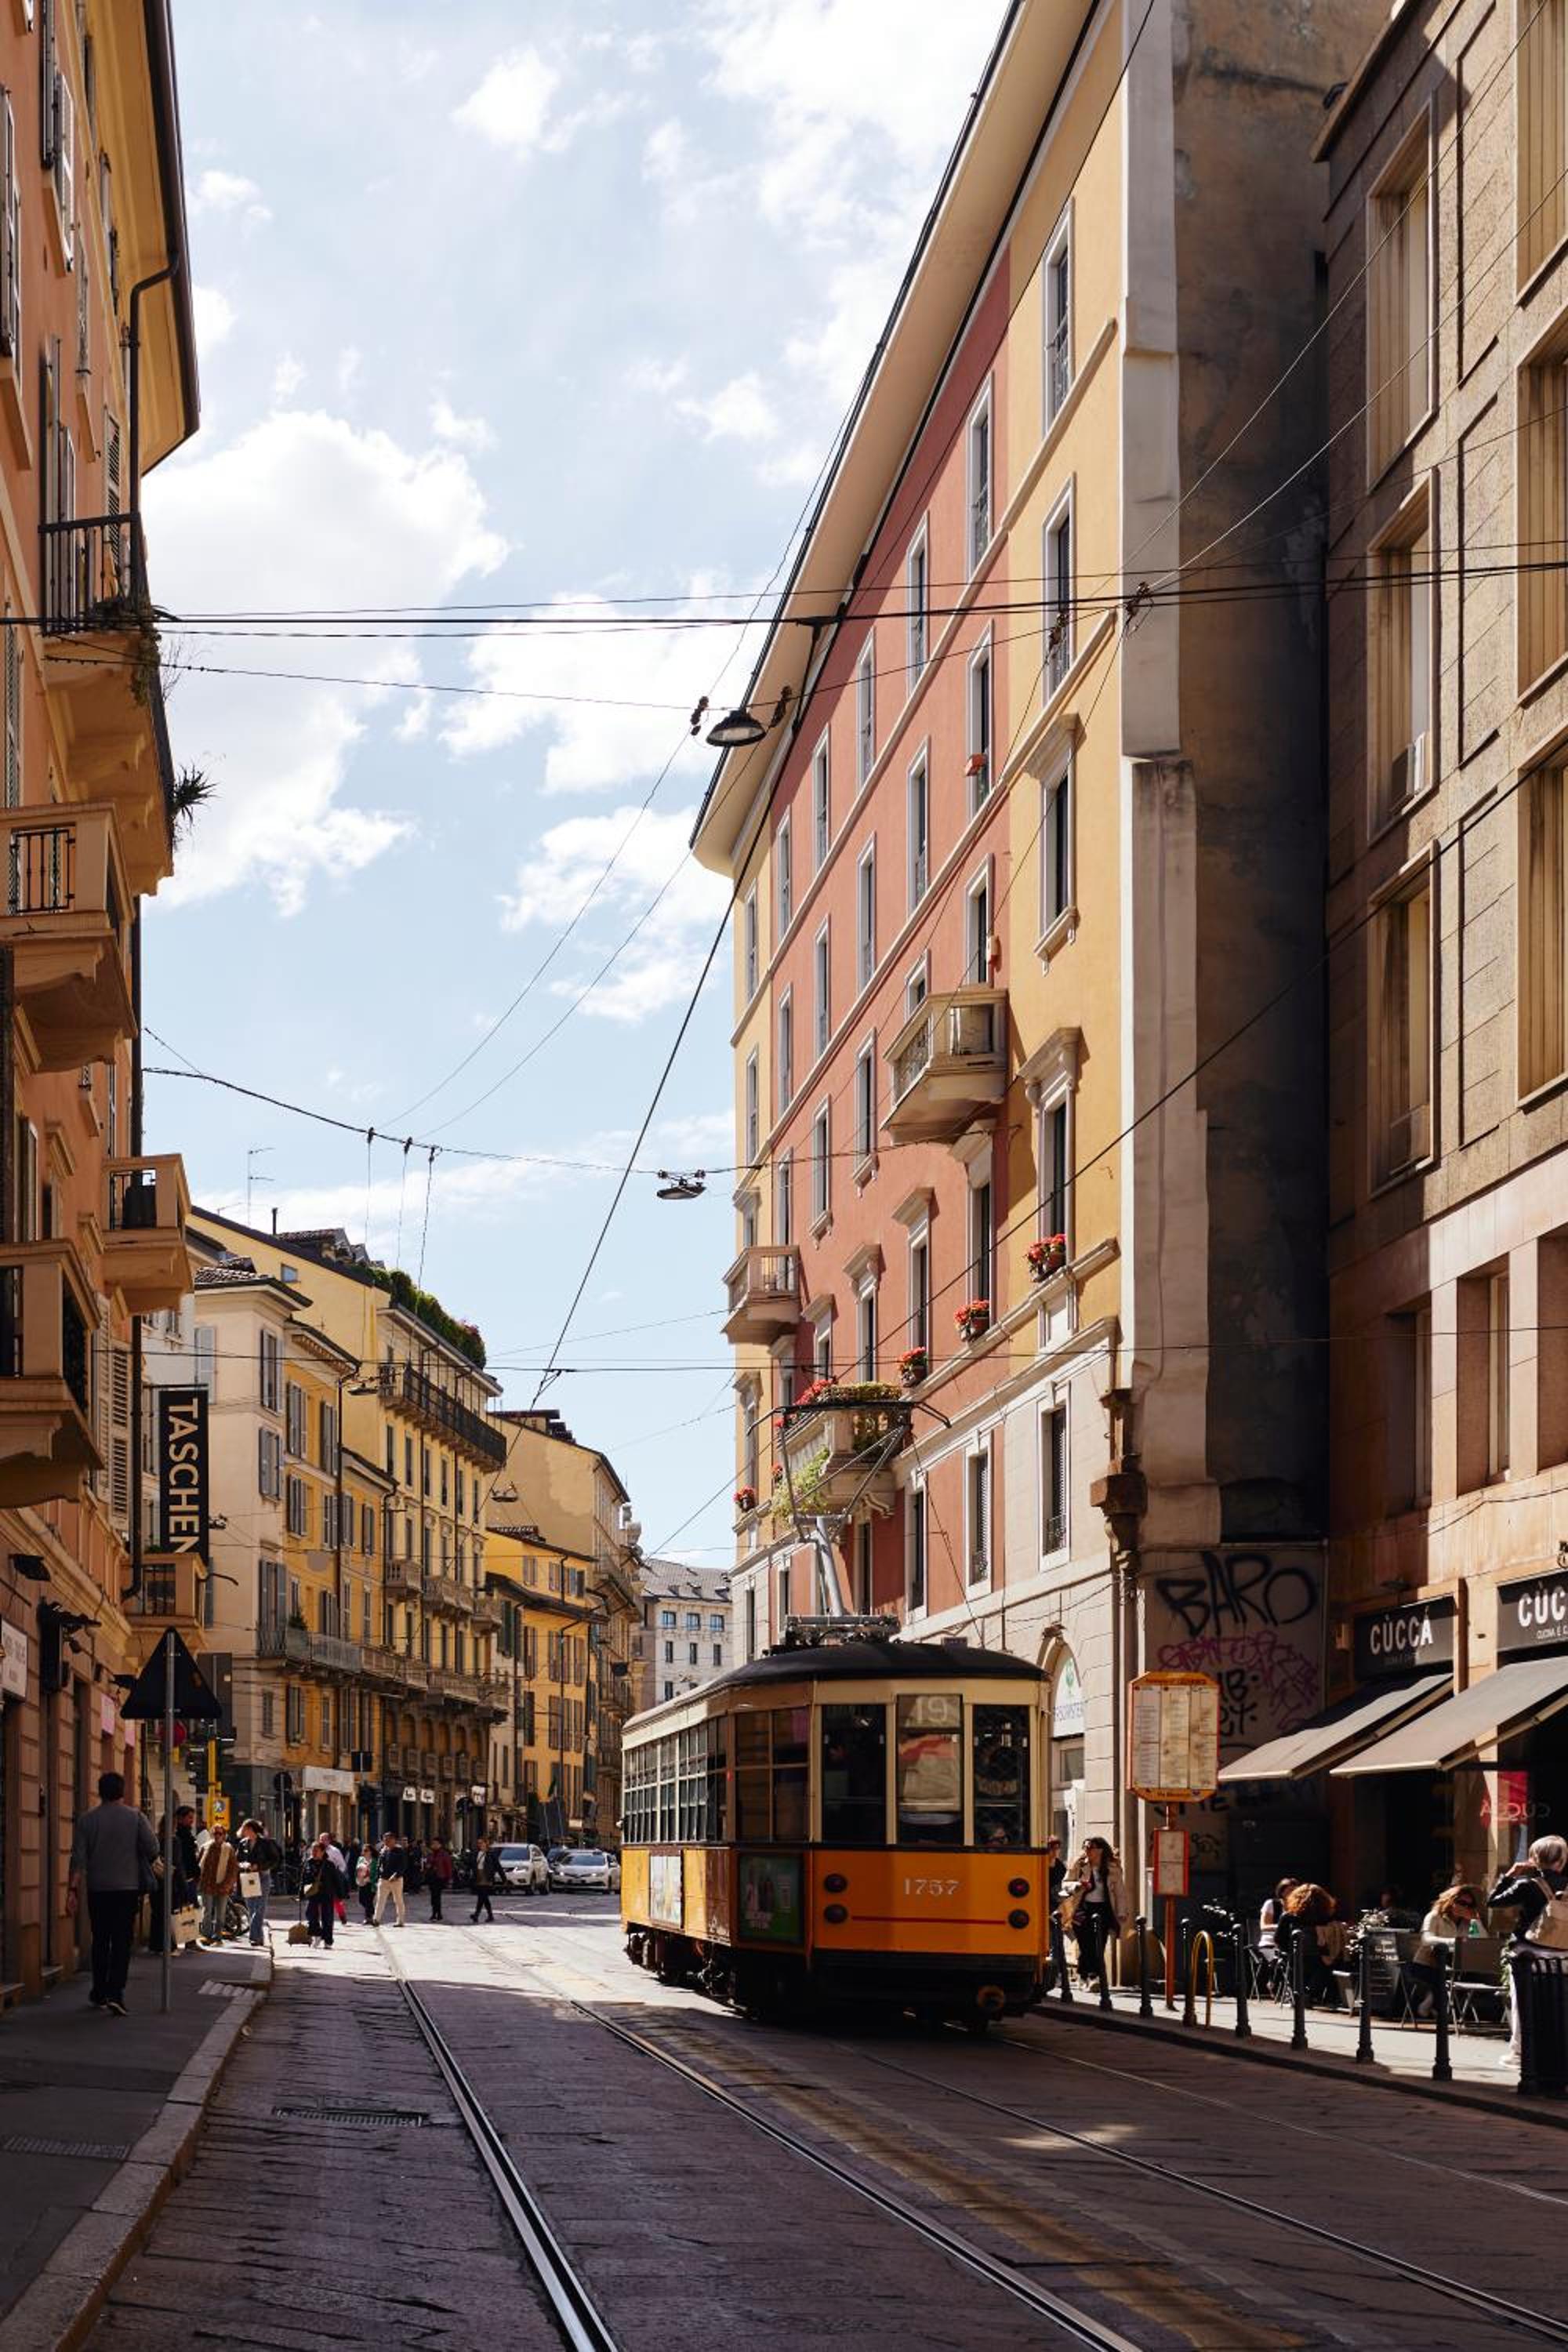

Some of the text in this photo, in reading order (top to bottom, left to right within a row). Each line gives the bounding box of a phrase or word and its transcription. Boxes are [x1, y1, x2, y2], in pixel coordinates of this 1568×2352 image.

[169, 1398, 200, 1553] TASCHEN
[914, 1695, 948, 1725] 19
[904, 1878, 960, 1897] 1757
